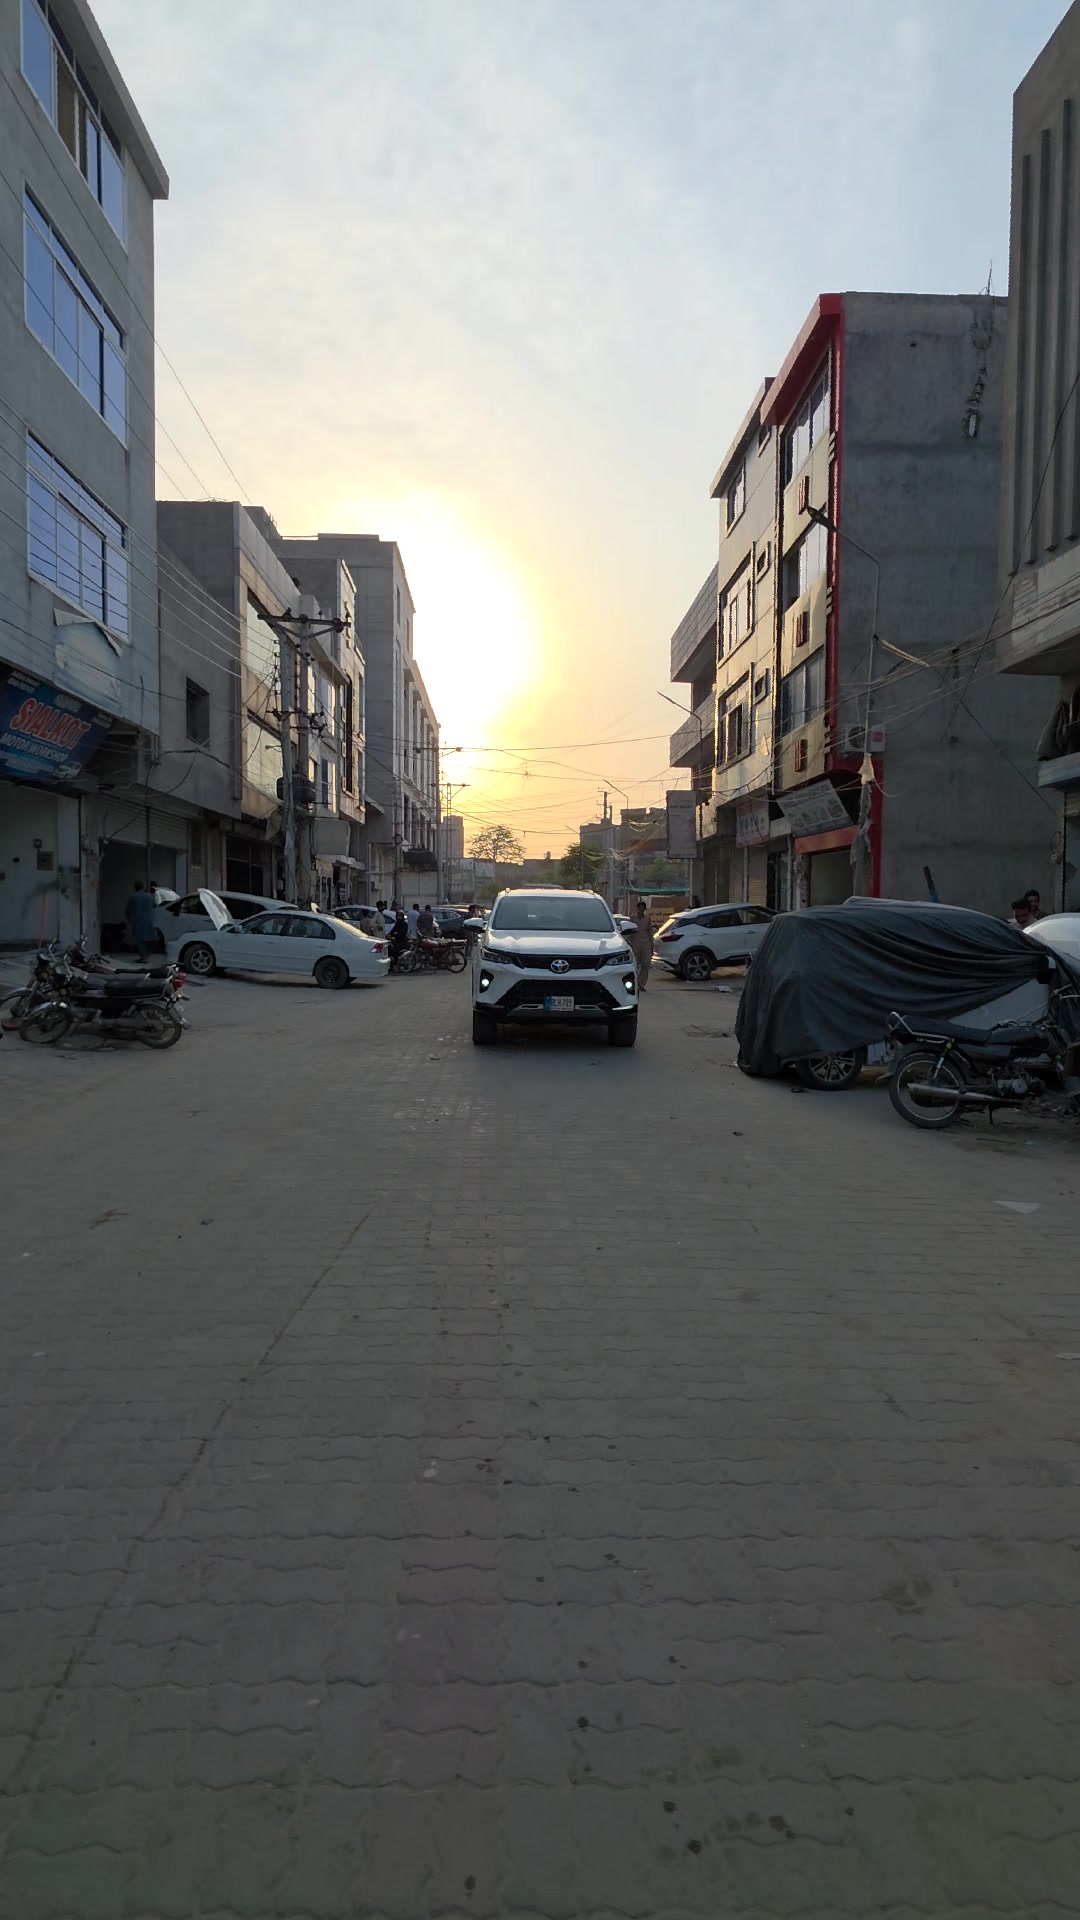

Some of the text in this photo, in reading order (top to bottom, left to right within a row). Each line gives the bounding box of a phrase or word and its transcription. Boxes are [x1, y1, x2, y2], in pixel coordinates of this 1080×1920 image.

[9, 697, 92, 750] SIALKOT
[0, 732, 31, 751] MOTOR
[29, 742, 69, 763] WORKSHOP
